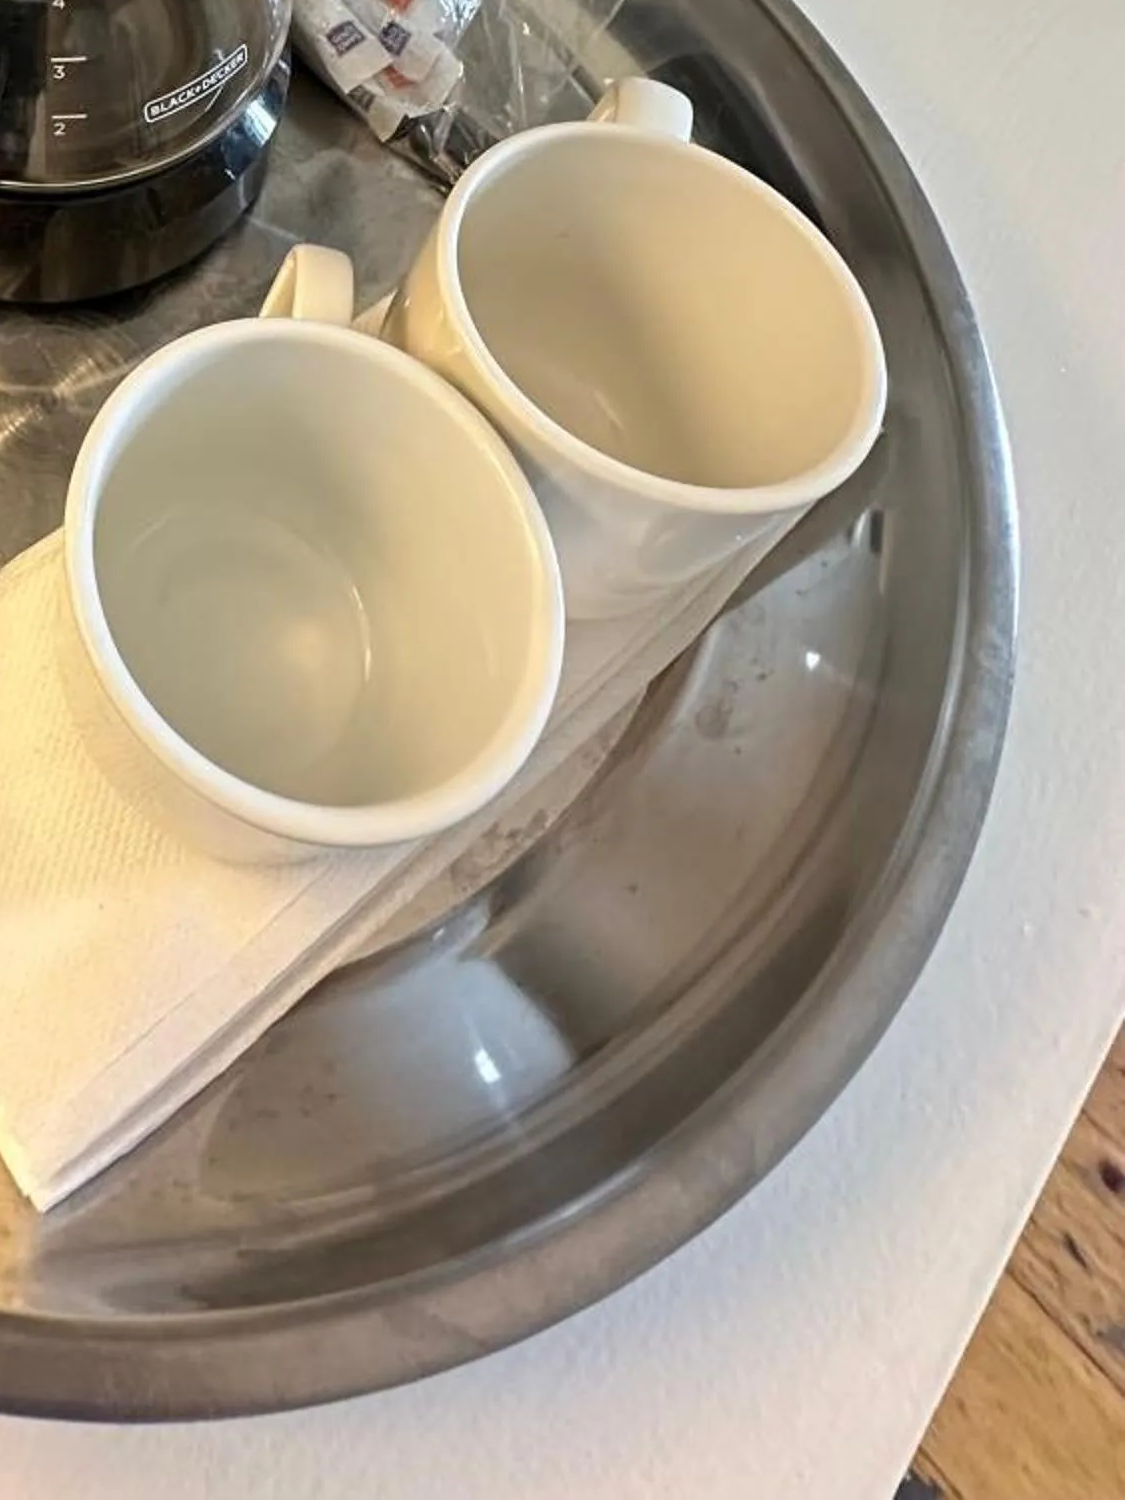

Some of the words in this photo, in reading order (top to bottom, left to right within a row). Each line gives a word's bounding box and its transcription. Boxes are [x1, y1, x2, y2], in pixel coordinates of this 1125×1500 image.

[53, 65, 66, 80] 3
[149, 50, 246, 117] BLACK+DECKER
[53, 123, 67, 137] 2
